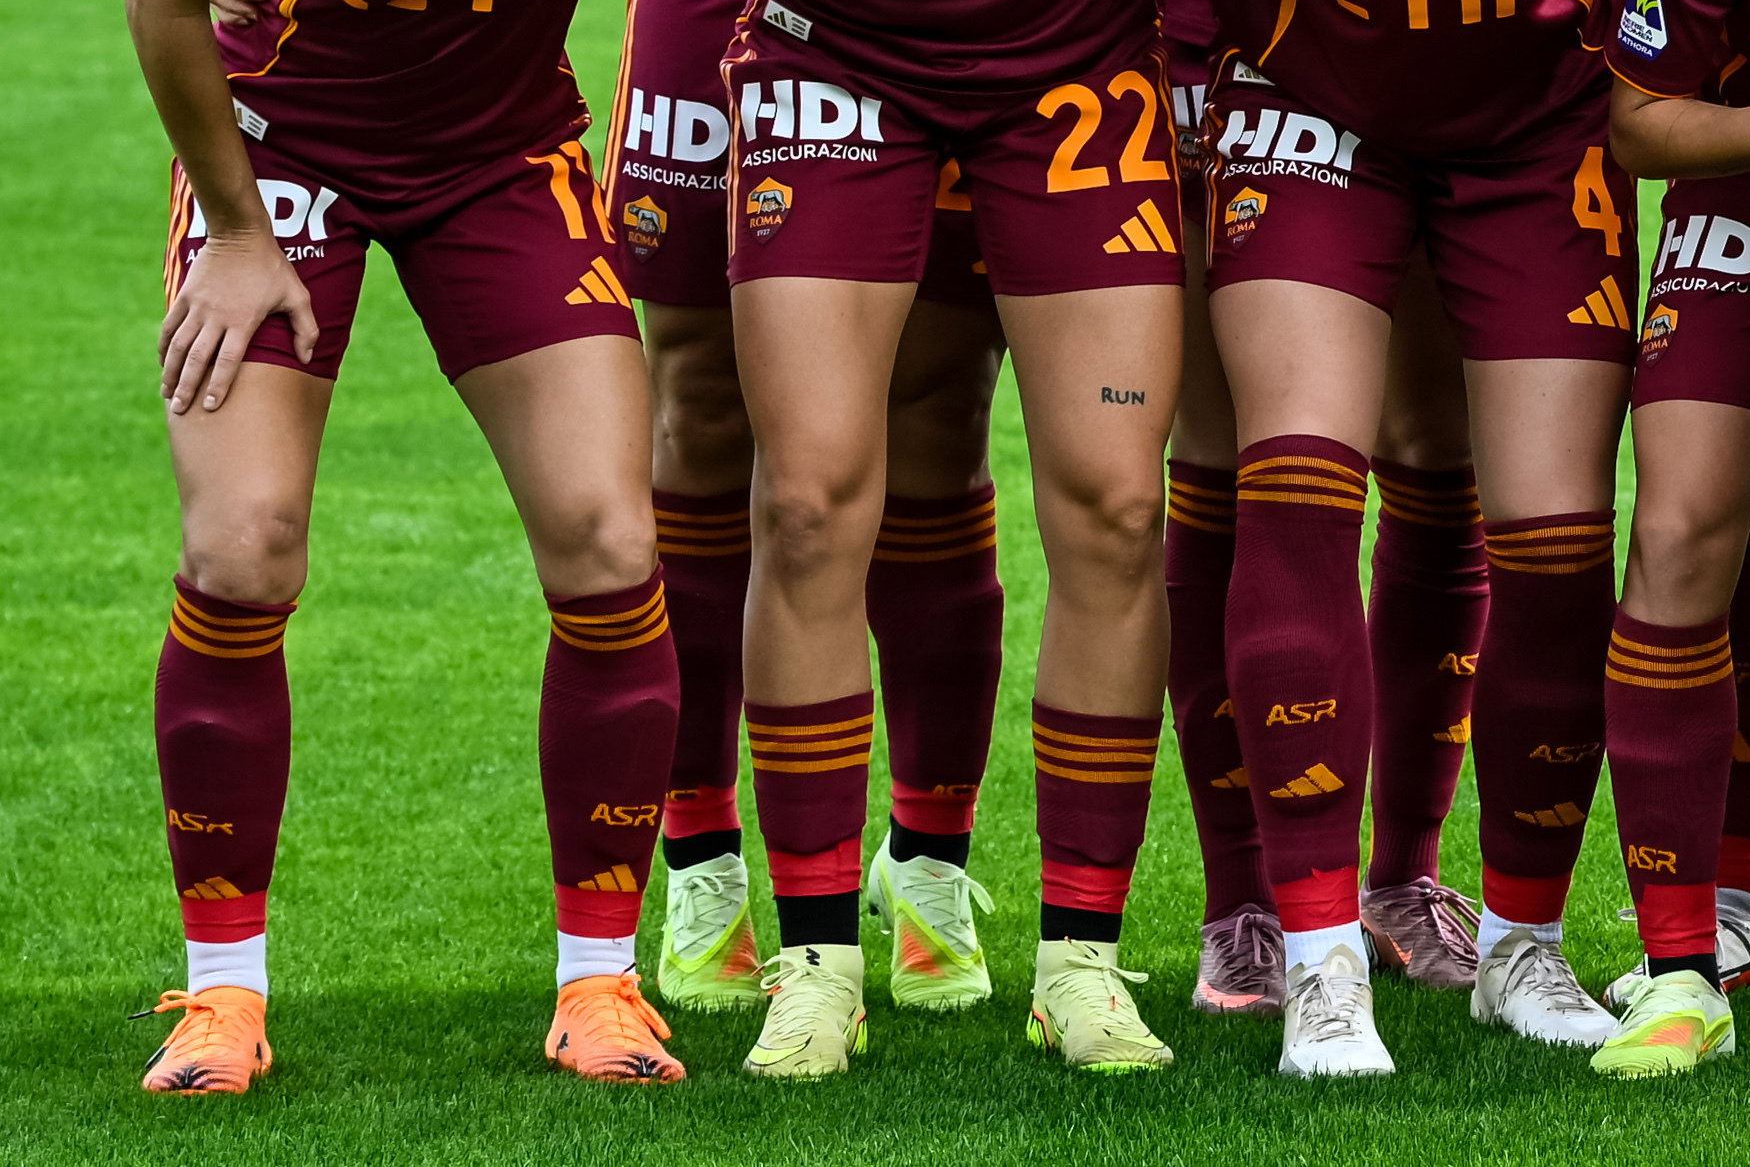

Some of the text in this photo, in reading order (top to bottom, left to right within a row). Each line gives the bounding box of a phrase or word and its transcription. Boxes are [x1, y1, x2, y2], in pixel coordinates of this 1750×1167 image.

[1620, 36, 1653, 57] ATHORA
[740, 79, 884, 143] HDI
[1036, 69, 1172, 194] 22
[1217, 109, 1361, 172] HDI
[741, 142, 878, 169] ASSICURAZIONI
[1221, 159, 1349, 191] ASSICURAZIONI
[1571, 146, 1623, 258] 4
[750, 214, 783, 229] ROMA
[1227, 220, 1256, 238] ROMA
[627, 231, 659, 248] ROMA
[1642, 338, 1669, 355] ROMA
[1101, 387, 1146, 406] RUN
[1266, 698, 1336, 726] ASR
[1529, 743, 1600, 764] ASR
[590, 803, 659, 827] ASR
[1627, 844, 1677, 875] ASR
